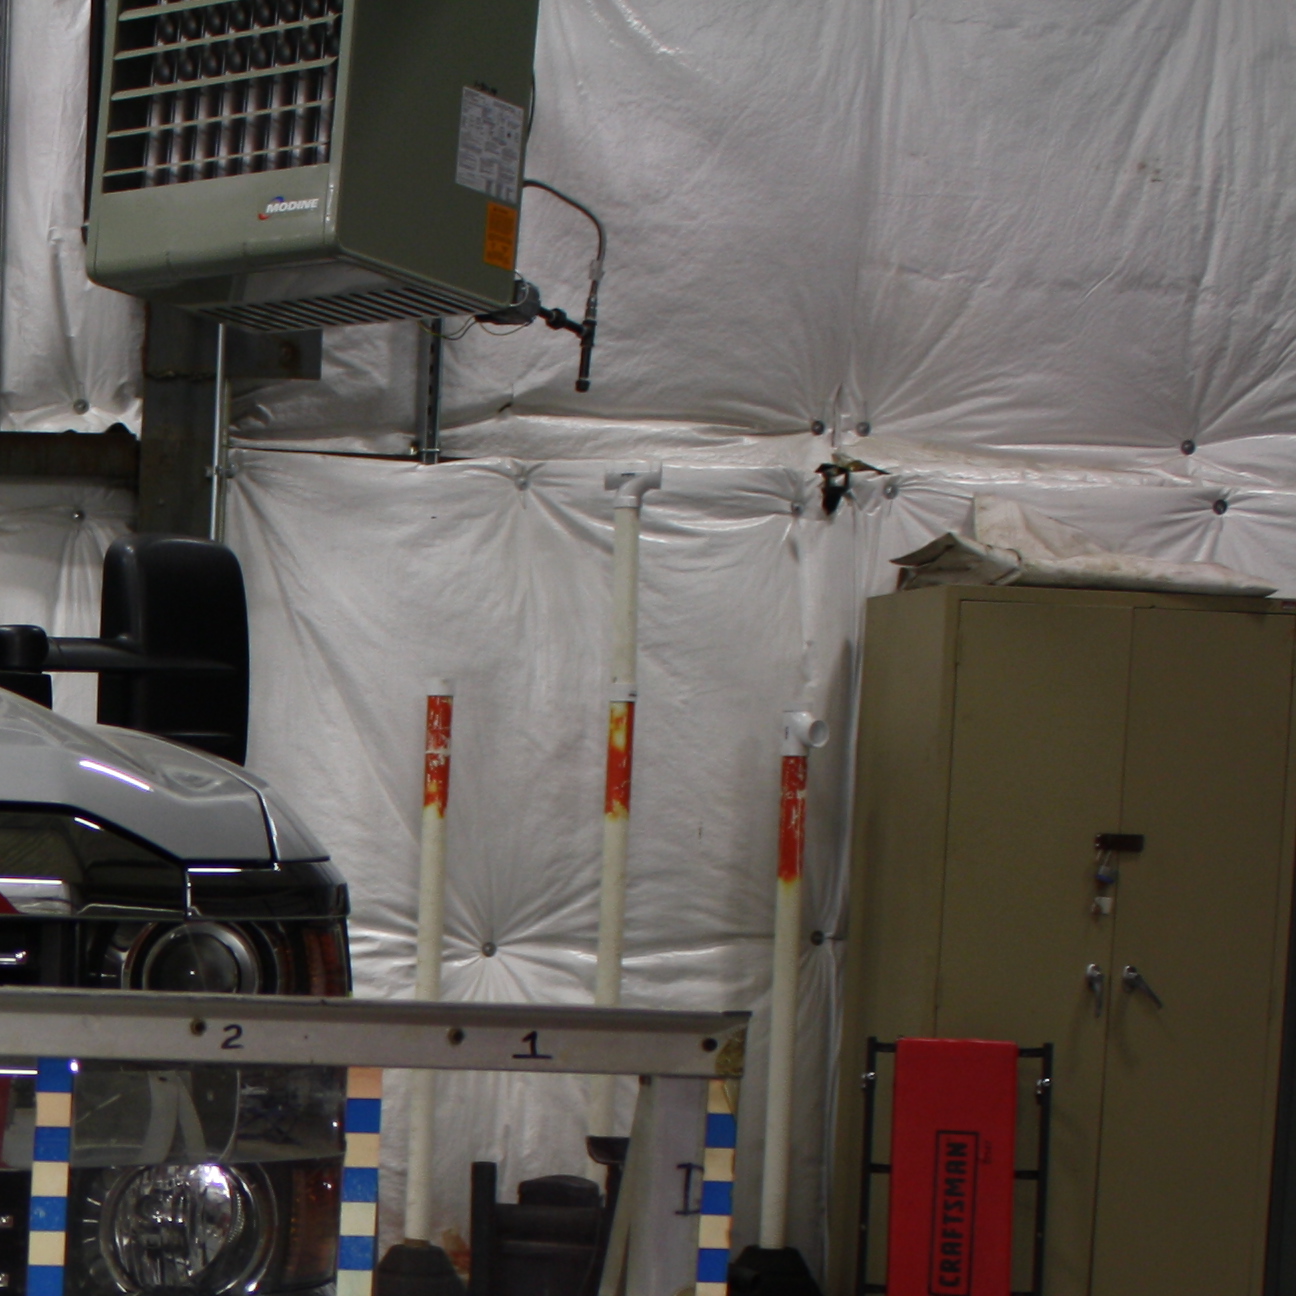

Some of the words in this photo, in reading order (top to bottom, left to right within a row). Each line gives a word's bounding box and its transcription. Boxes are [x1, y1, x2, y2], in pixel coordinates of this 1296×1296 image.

[266, 199, 319, 213] MODINE
[219, 1023, 246, 1050] 2
[512, 1030, 553, 1060] 1
[938, 1141, 969, 1288] CRAFTSMAN
